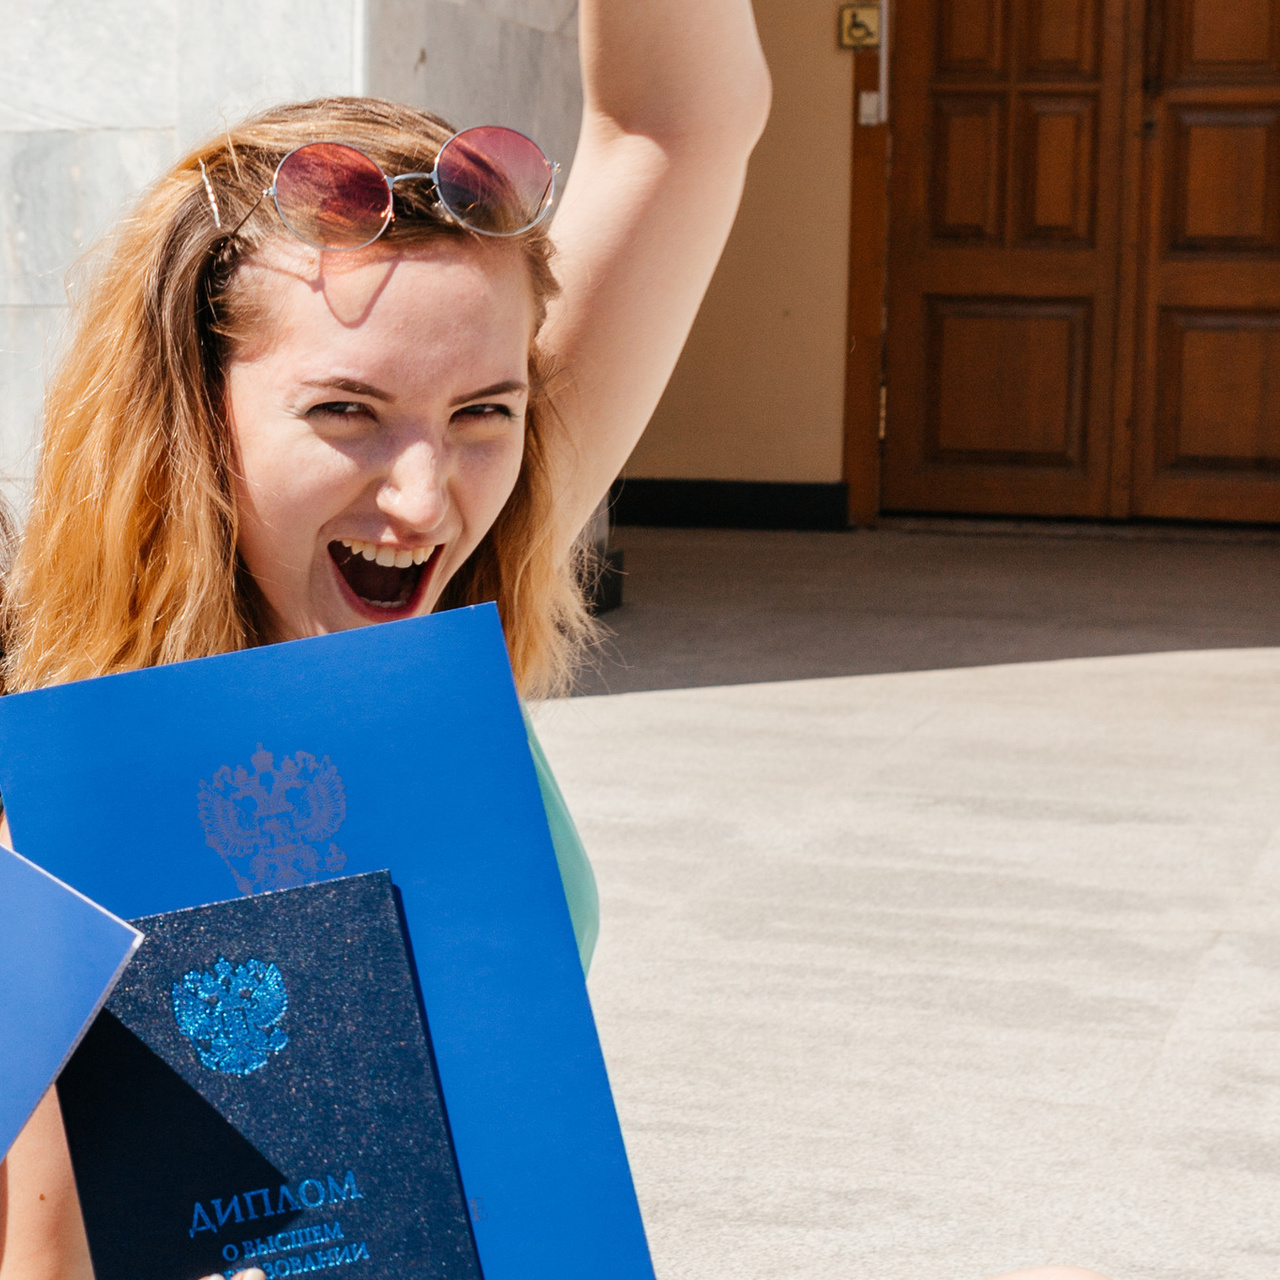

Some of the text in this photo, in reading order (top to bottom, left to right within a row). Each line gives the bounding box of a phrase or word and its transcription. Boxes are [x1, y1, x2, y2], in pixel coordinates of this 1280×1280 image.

[188, 1169, 363, 1238] ДИПЛОМ
[222, 1221, 345, 1262] О ВЫСШЕМ
